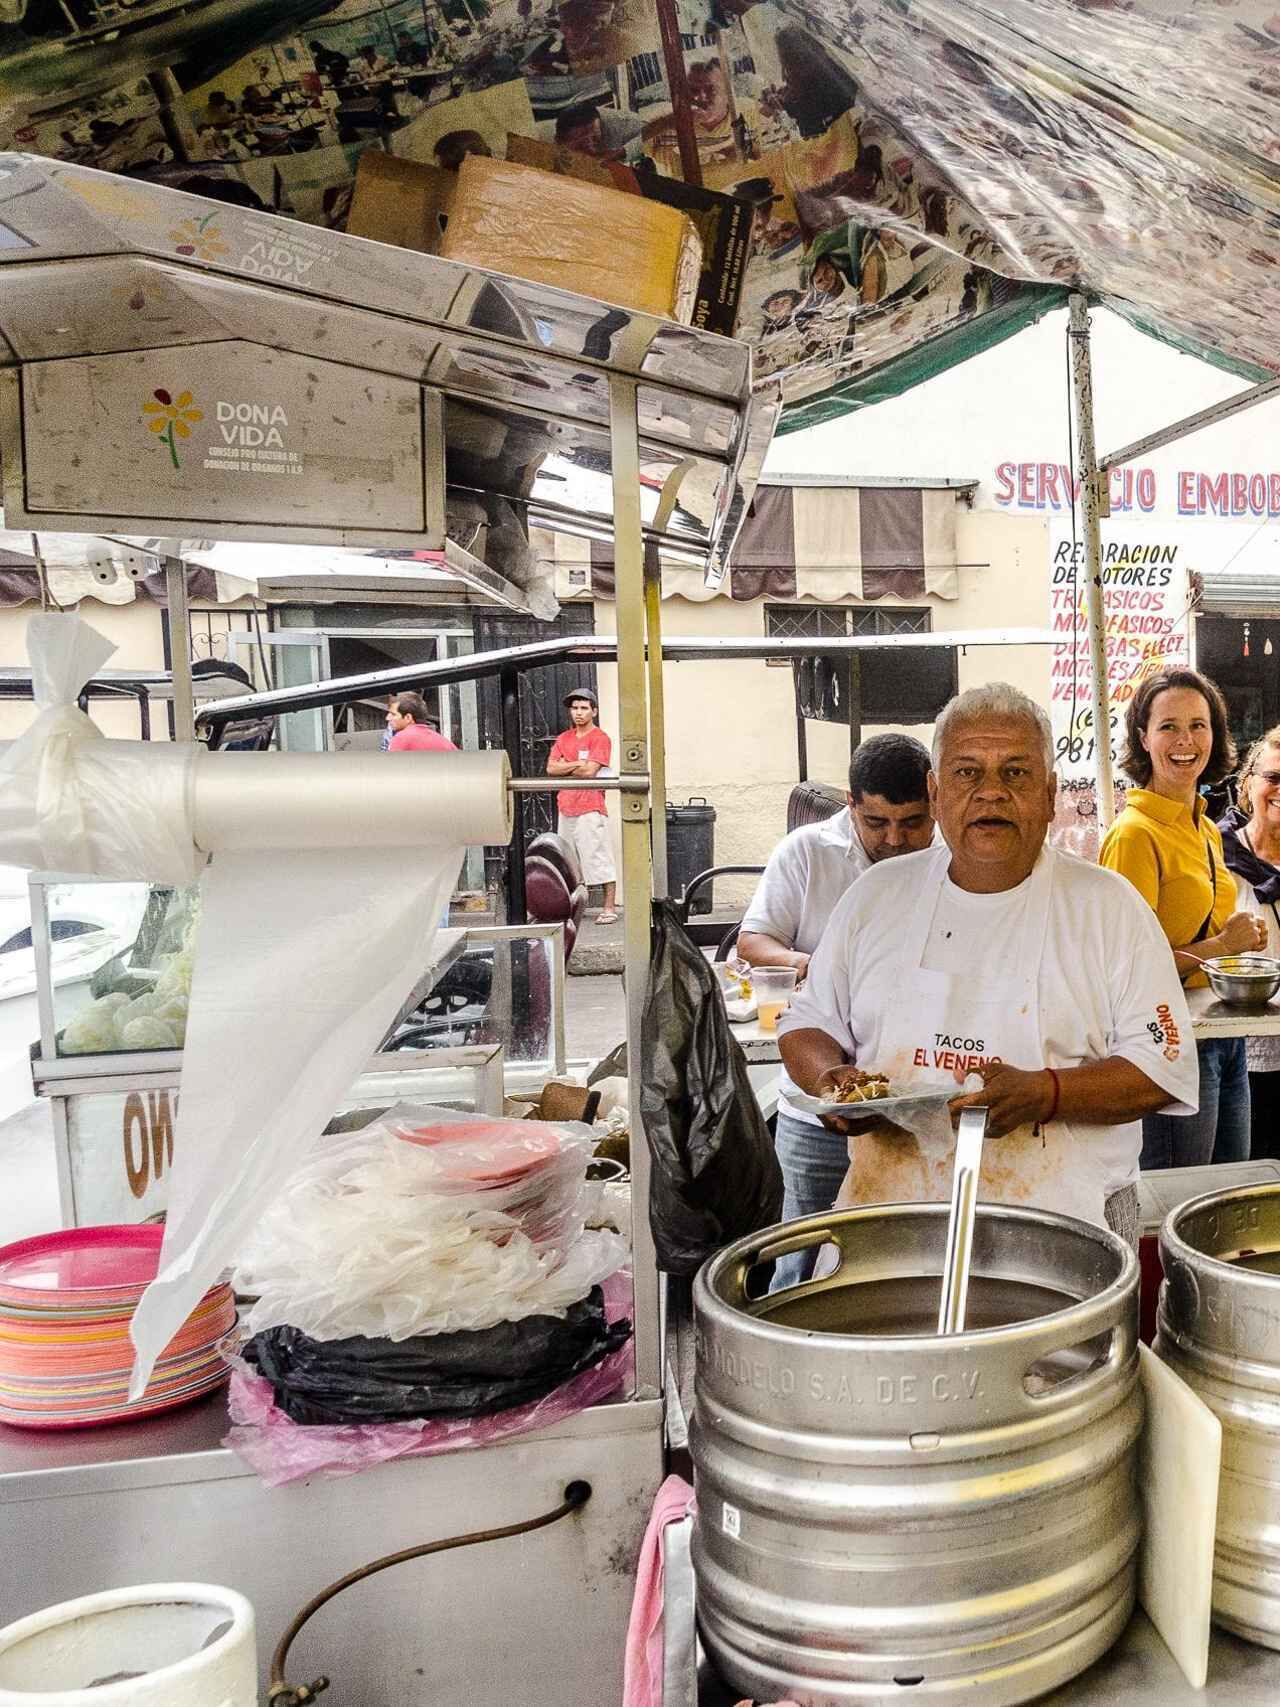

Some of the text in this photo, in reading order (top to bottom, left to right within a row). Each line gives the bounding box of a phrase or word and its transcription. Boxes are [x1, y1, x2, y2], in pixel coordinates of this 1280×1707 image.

[216, 401, 288, 426] DONA
[220, 425, 284, 449] VIDA
[994, 462, 1157, 513] SERVCIO
[1053, 566, 1172, 586] DE OTORES
[1051, 588, 1165, 612] TRIASICOS
[934, 1032, 985, 1053] TACOS
[913, 1047, 930, 1068] EL
[810, 1372, 863, 1404] S.A.
[876, 1375, 919, 1405] DE
[931, 1369, 984, 1401] C.V.
